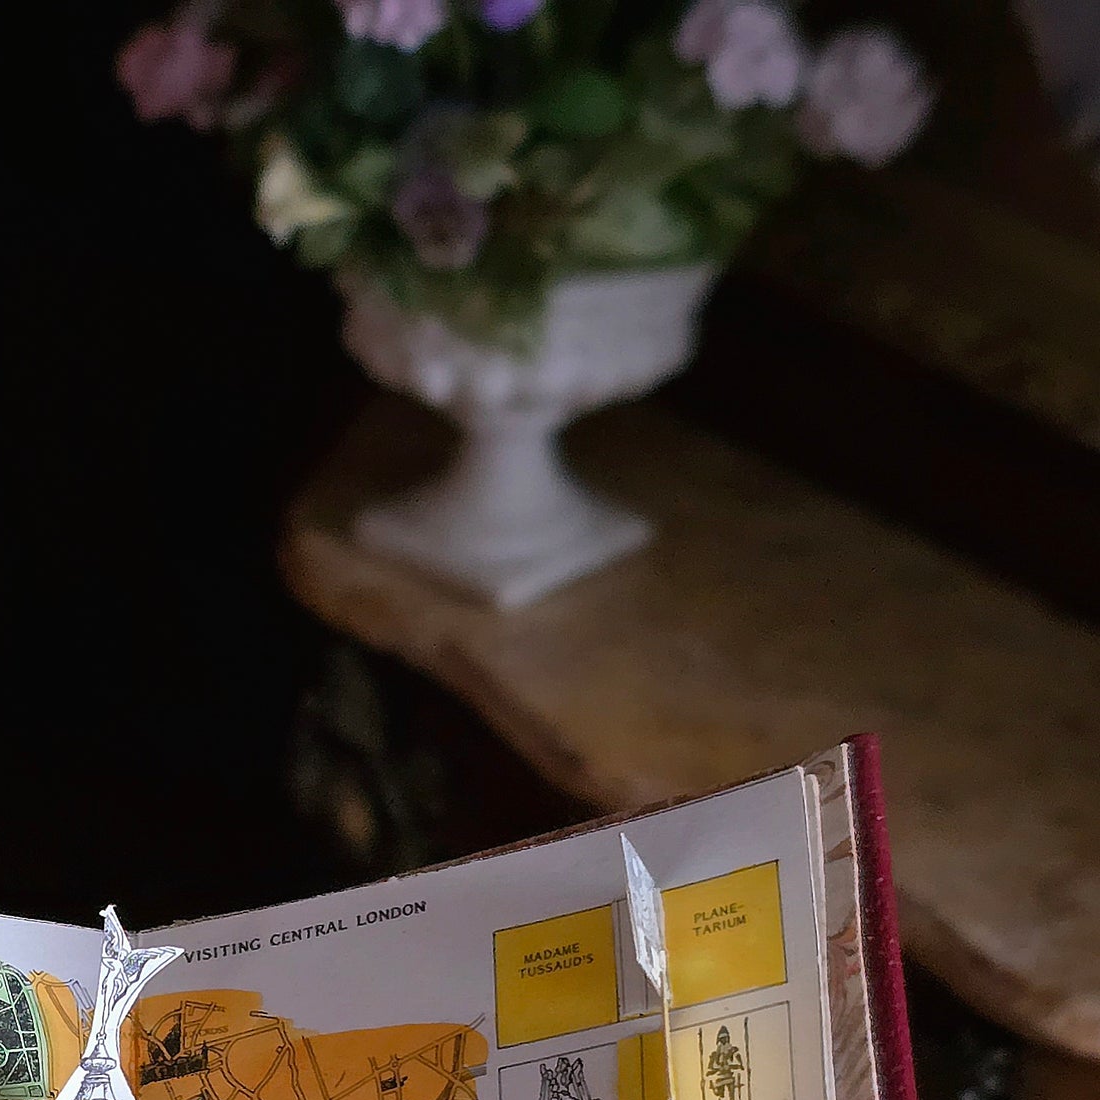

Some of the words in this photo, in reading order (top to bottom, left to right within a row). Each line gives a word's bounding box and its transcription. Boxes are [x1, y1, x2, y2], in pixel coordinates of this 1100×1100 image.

[693, 902, 744, 924] PLANE-
[184, 938, 261, 963] VISITING
[270, 920, 347, 946] CENTRAL
[356, 901, 426, 926] LONDON
[692, 914, 747, 936] TARIUM
[524, 942, 580, 964] MADAME
[519, 954, 594, 978] TUSSAUD'S
